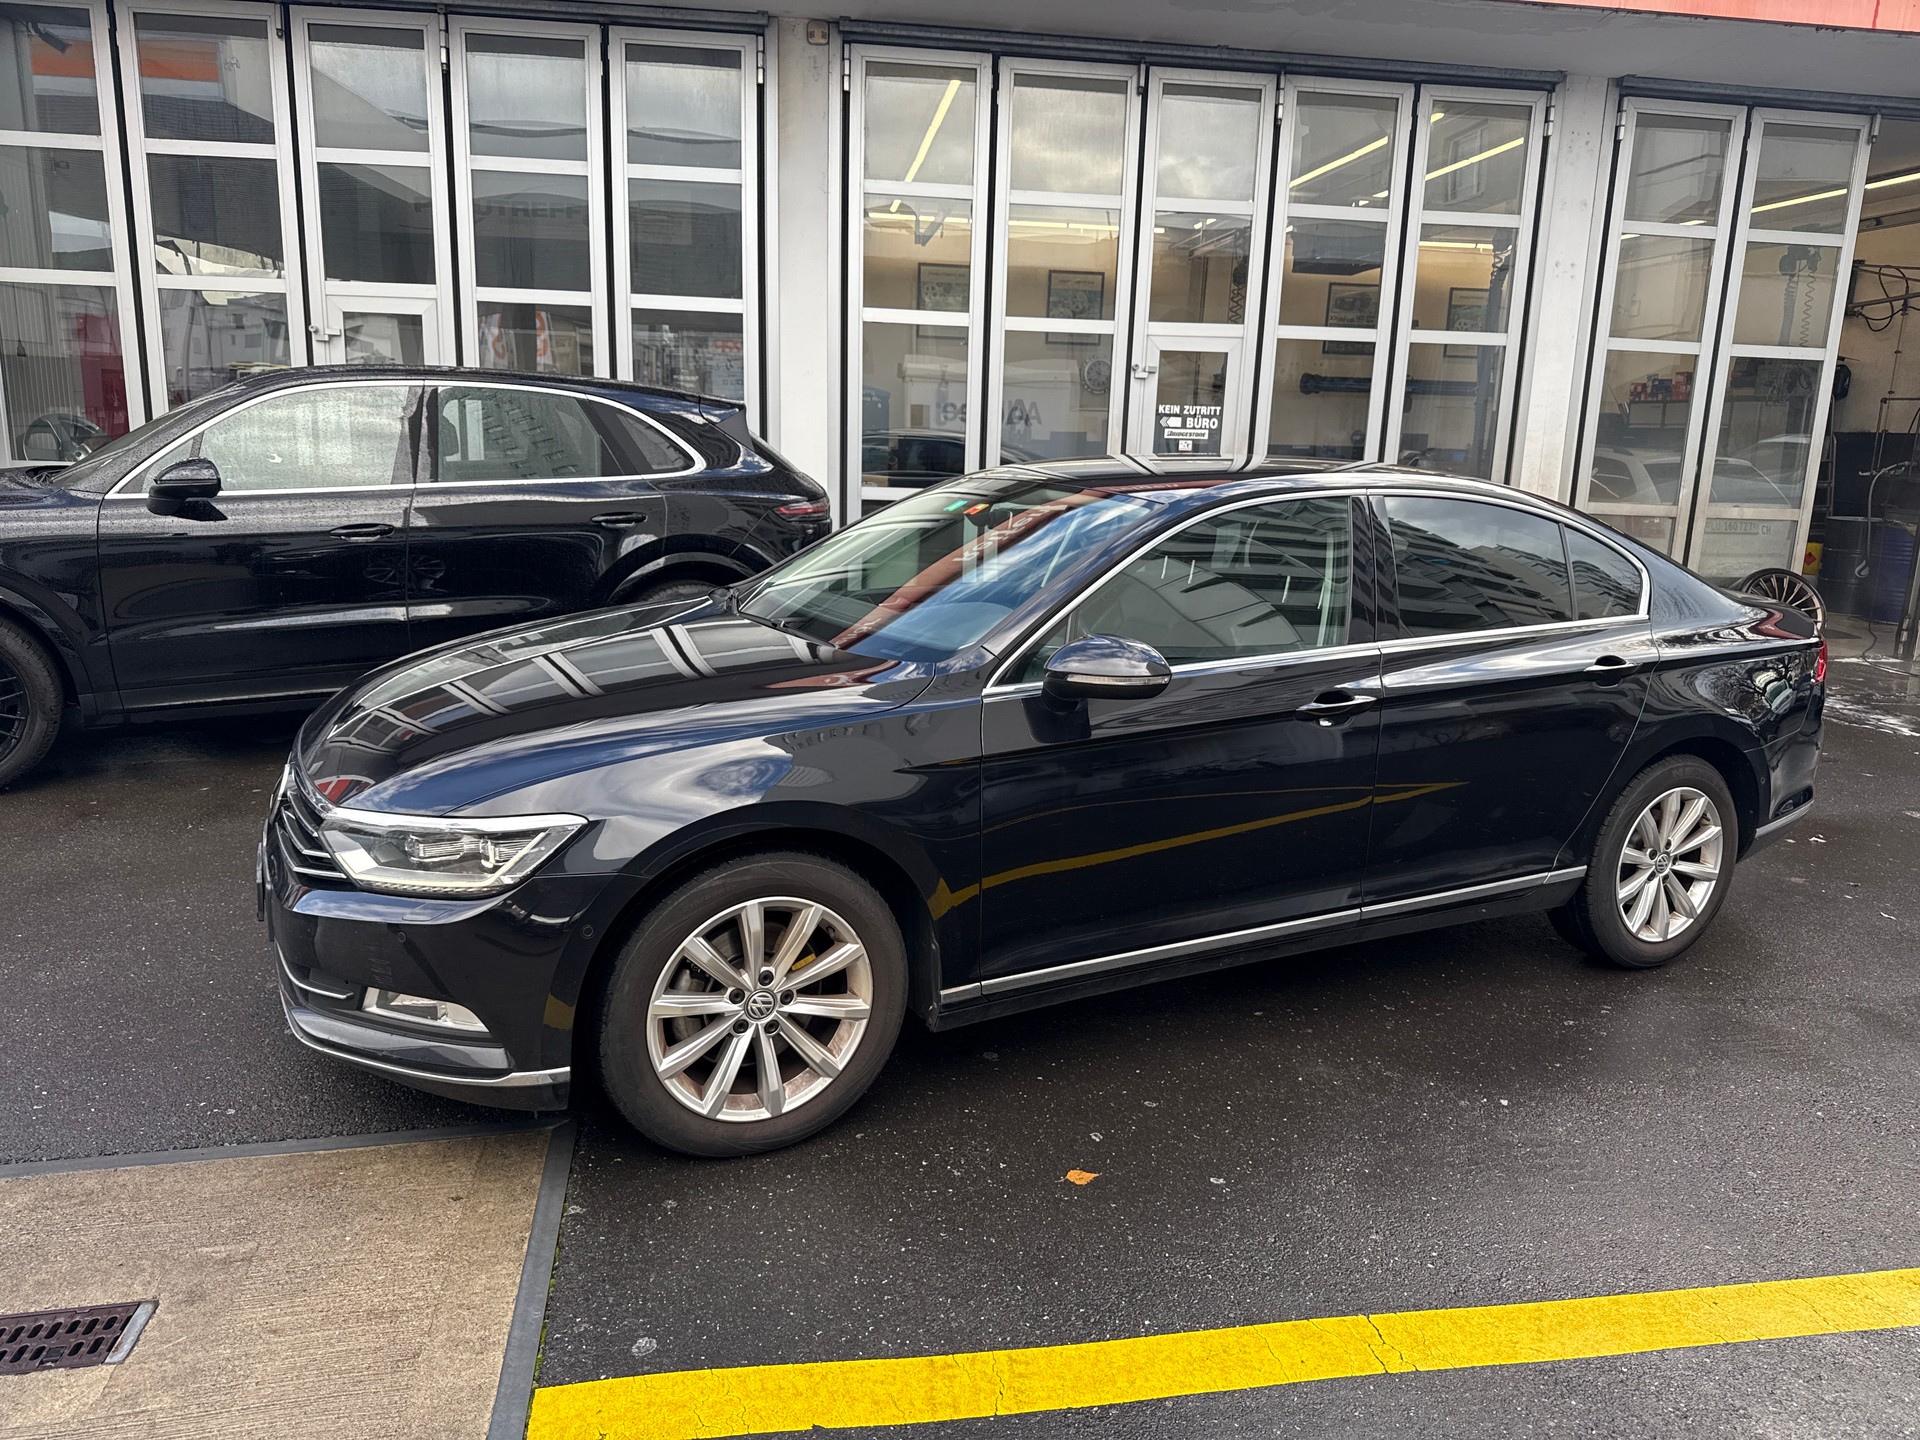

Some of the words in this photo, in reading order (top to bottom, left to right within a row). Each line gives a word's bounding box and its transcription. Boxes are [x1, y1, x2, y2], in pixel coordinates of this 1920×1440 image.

[1158, 404, 1180, 414] KEIN
[1183, 405, 1221, 416] ZUTRITT
[1186, 415, 1218, 429] BÜRO
[1166, 430, 1206, 438] BRIDGESTONE
[1761, 525, 1771, 535] CH
